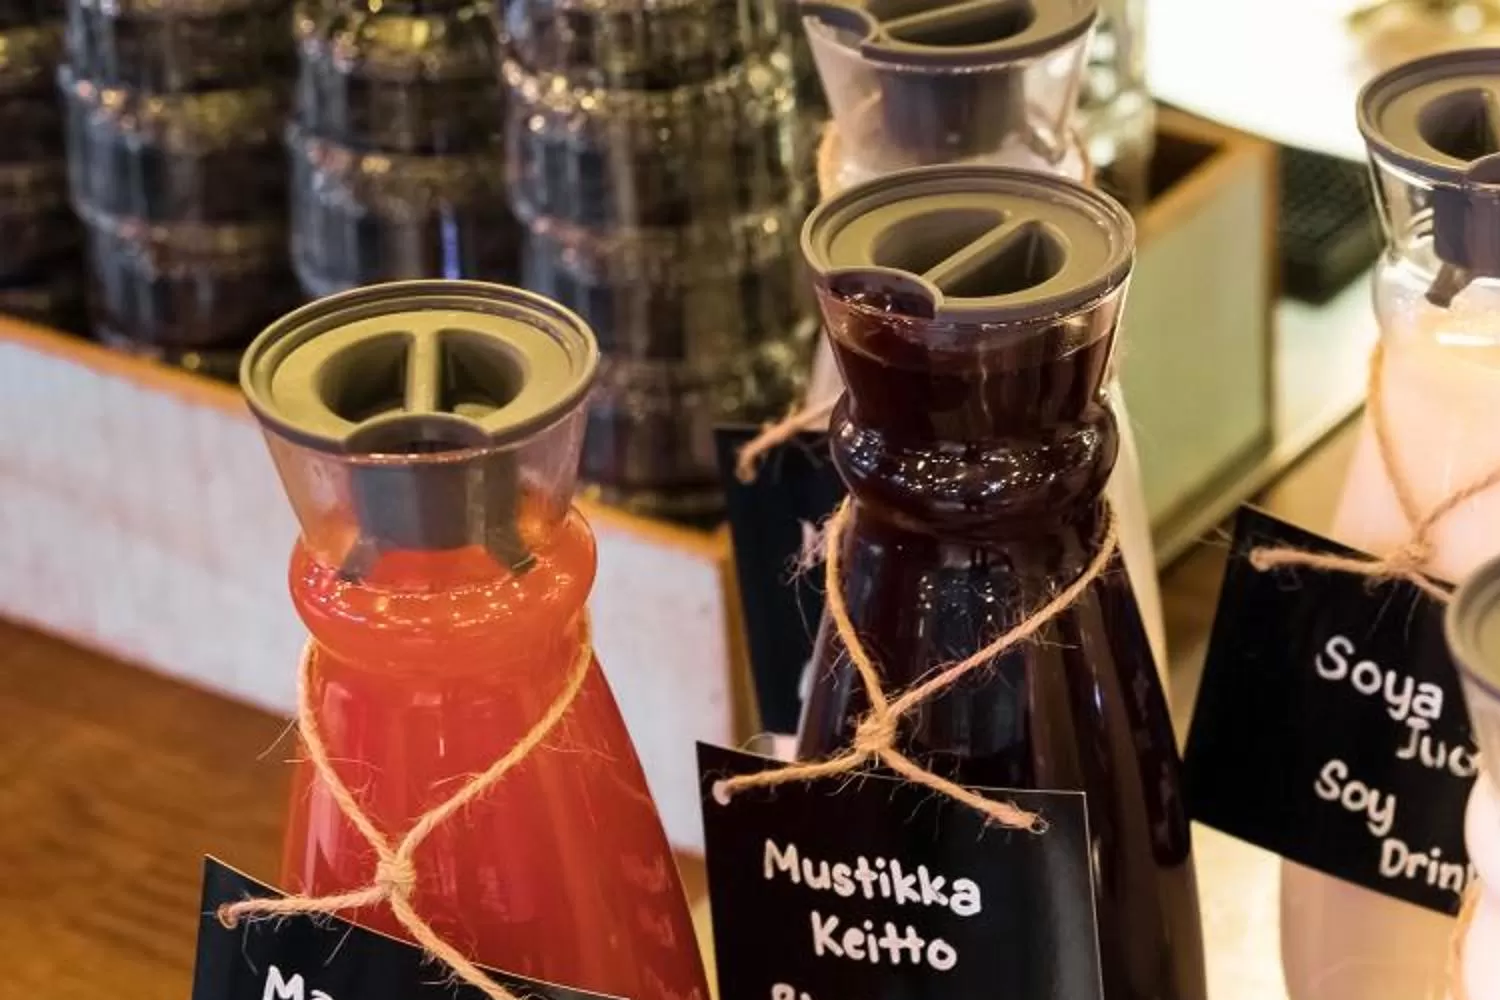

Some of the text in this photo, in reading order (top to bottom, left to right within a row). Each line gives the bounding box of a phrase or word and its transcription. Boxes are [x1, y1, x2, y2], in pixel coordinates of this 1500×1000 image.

[1315, 635, 1443, 722] Soya
[1314, 758, 1396, 838] Soy
[763, 838, 982, 917] Mustikka
[810, 911, 958, 971] Keitto
